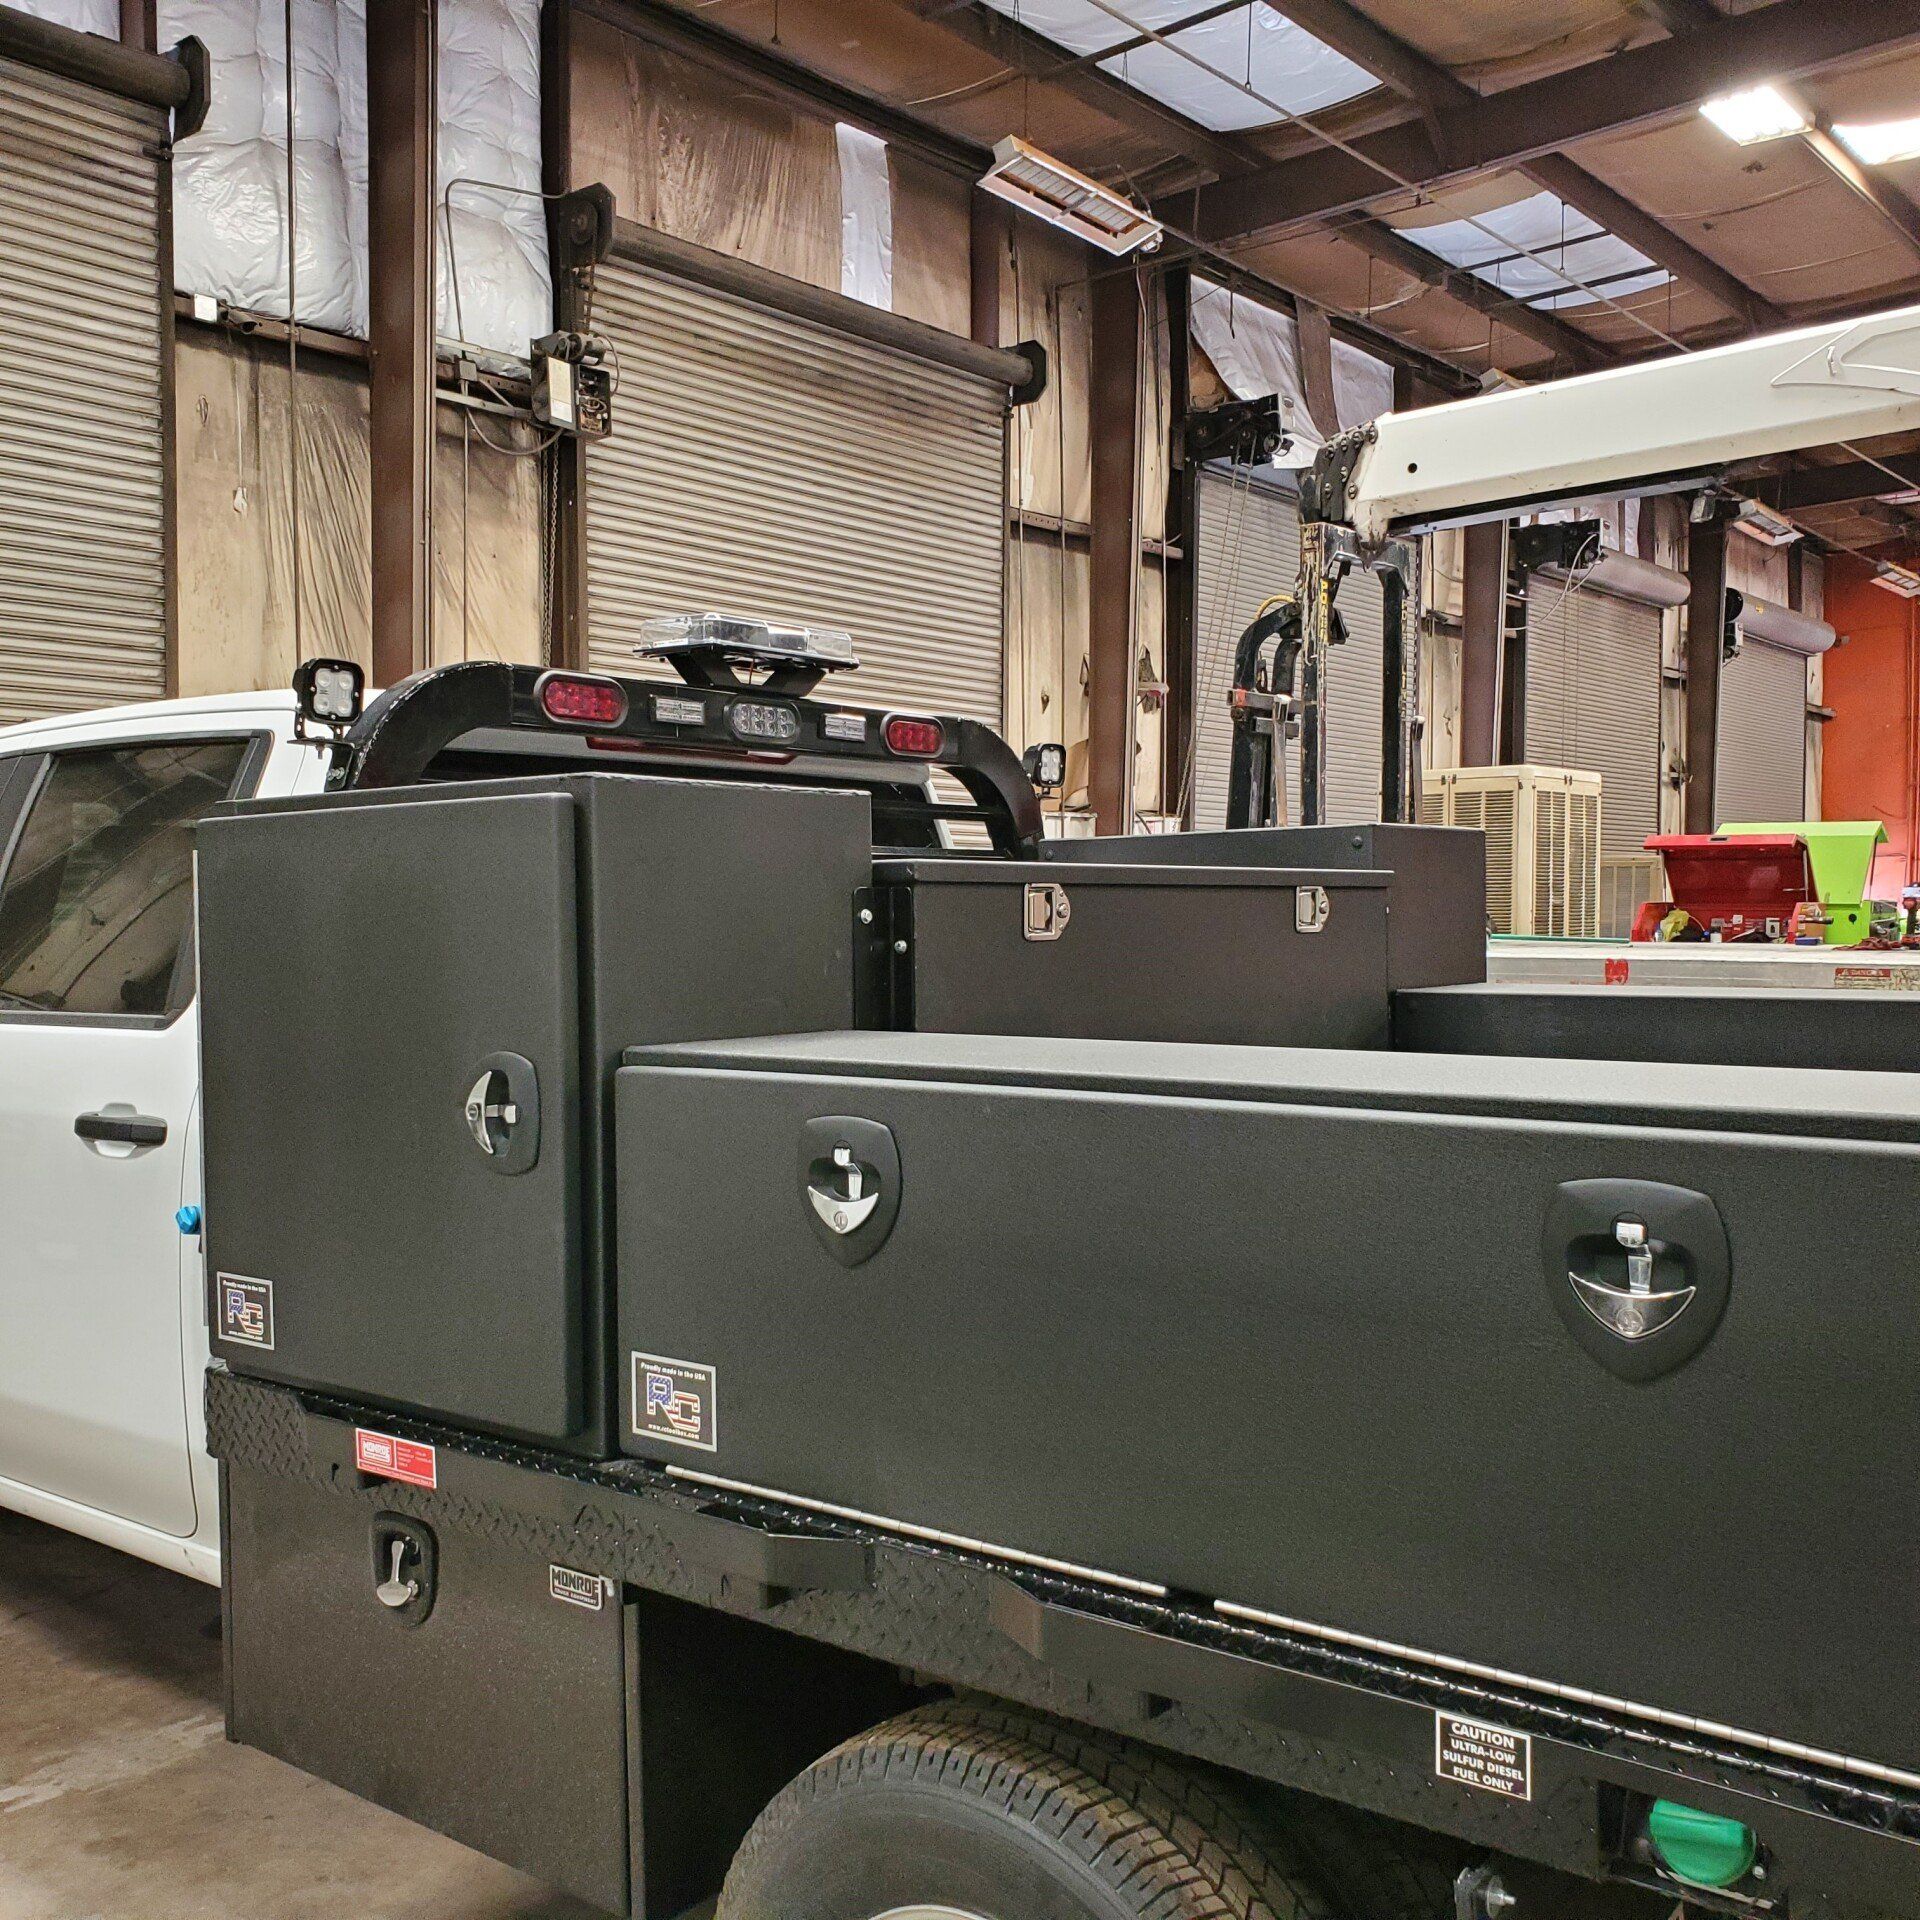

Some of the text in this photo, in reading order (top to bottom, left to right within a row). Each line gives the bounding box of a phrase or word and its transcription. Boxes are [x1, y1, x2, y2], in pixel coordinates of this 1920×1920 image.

[226, 1288, 264, 1336] RC
[640, 1362, 706, 1381] Proudly made in the USA
[646, 1372, 701, 1433] RC
[648, 1423, 700, 1439] www.rctoolbox.com
[552, 1567, 599, 1595] MONROE
[1451, 1722, 1515, 1749] CAUTION
[1451, 1738, 1516, 1765] ULTRA-LOW
[1442, 1750, 1525, 1781] SULFUR DIESEL
[1453, 1766, 1515, 1791] FUEL ONLY
